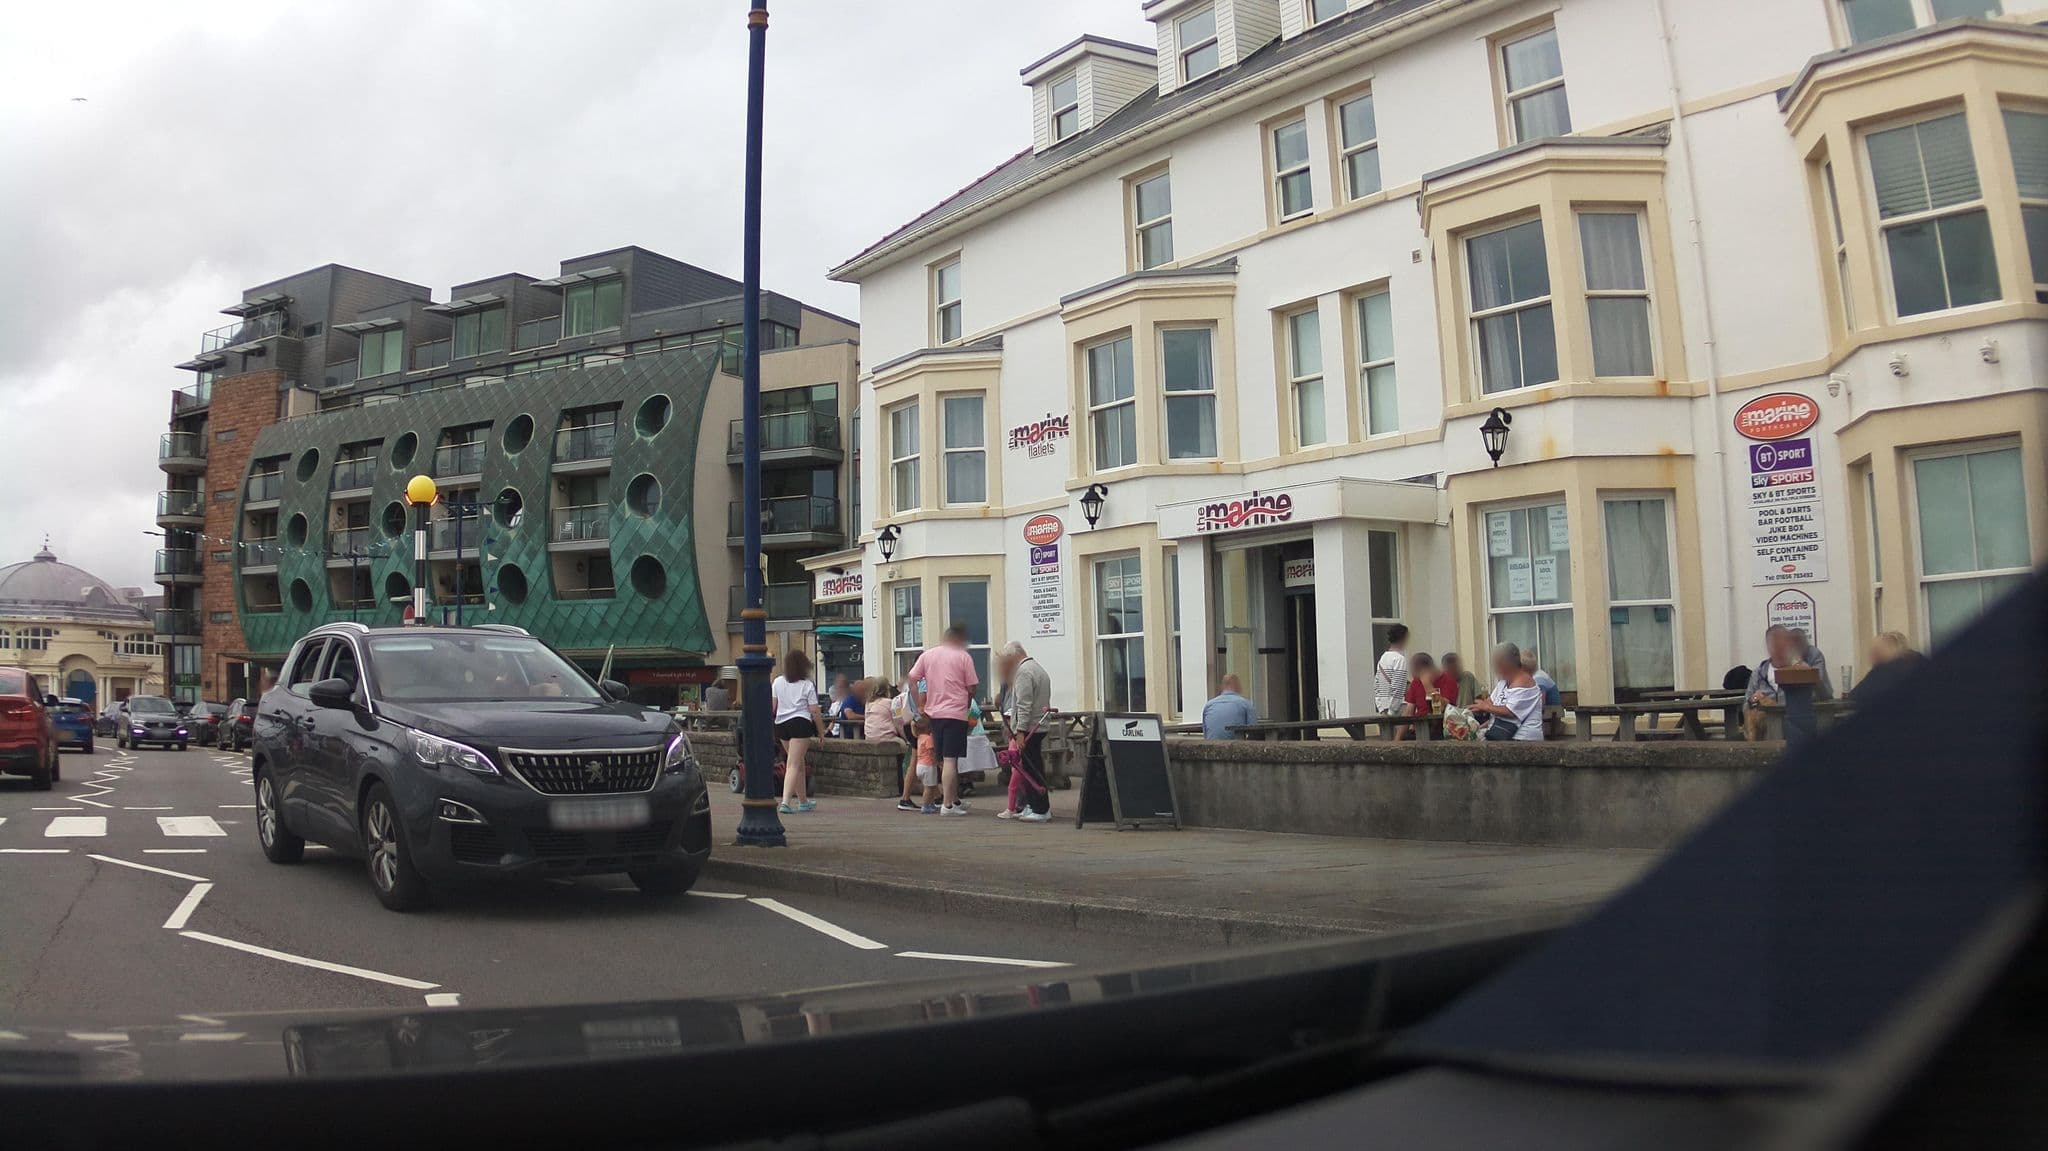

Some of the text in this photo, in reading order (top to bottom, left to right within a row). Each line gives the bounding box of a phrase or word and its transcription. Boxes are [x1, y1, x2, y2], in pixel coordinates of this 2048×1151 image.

[1748, 400, 1811, 426] marine
[1760, 448, 1806, 463] BT SPORT
[1771, 471, 1813, 485] SPORTS
[1753, 491, 1767, 500] SKY
[1787, 486, 1816, 496] SPORTS
[1197, 490, 1292, 532] the marine
[1759, 509, 1779, 517] POOL
[1787, 506, 1811, 514] DARTS
[1758, 514, 1814, 526] BAR FOOTBALL
[1769, 524, 1804, 534] JUKE BOX
[1756, 531, 1818, 544] VIDEO MACHINES
[1757, 544, 1819, 556] SELF CONTAINED
[1770, 553, 1806, 563] FLATLETS
[826, 571, 863, 595] marine
[1776, 600, 1808, 611] marine
[1122, 729, 1144, 737] CARLING
